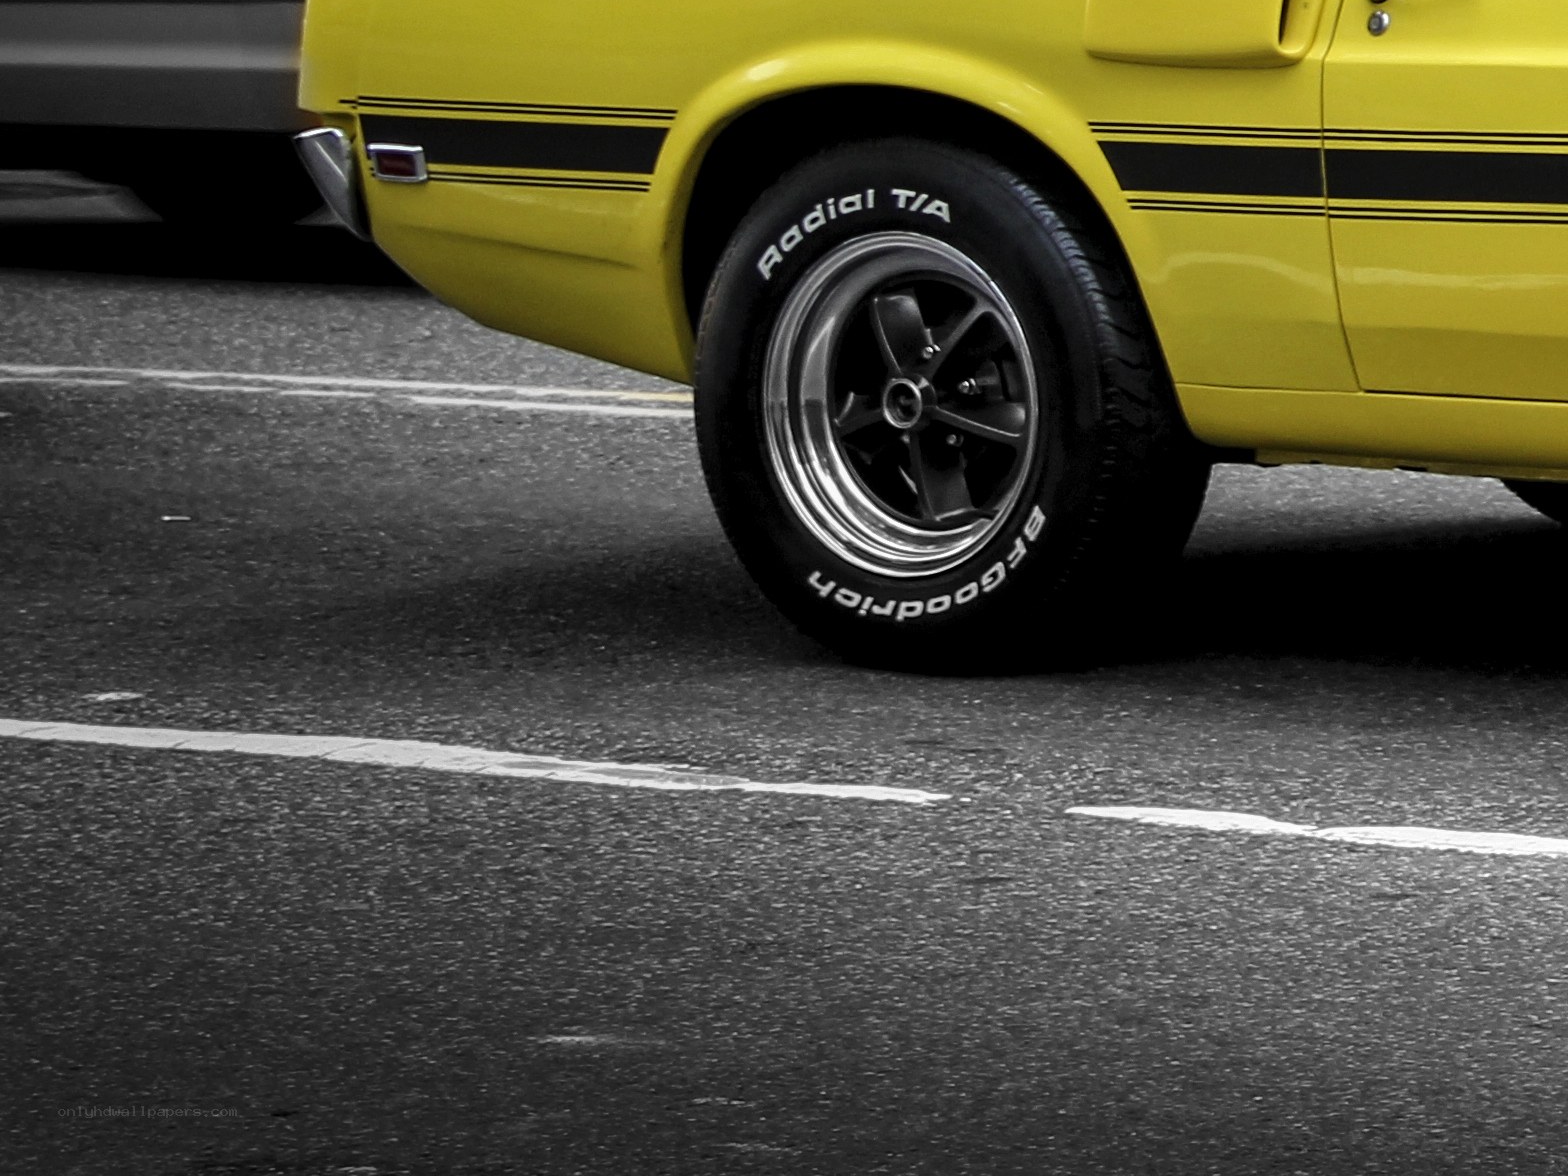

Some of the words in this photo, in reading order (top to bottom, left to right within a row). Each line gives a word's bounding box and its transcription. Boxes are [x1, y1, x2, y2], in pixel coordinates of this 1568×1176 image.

[757, 189, 875, 281] Radial
[890, 188, 951, 224] T/A
[807, 504, 1047, 622] BFGoodrich
